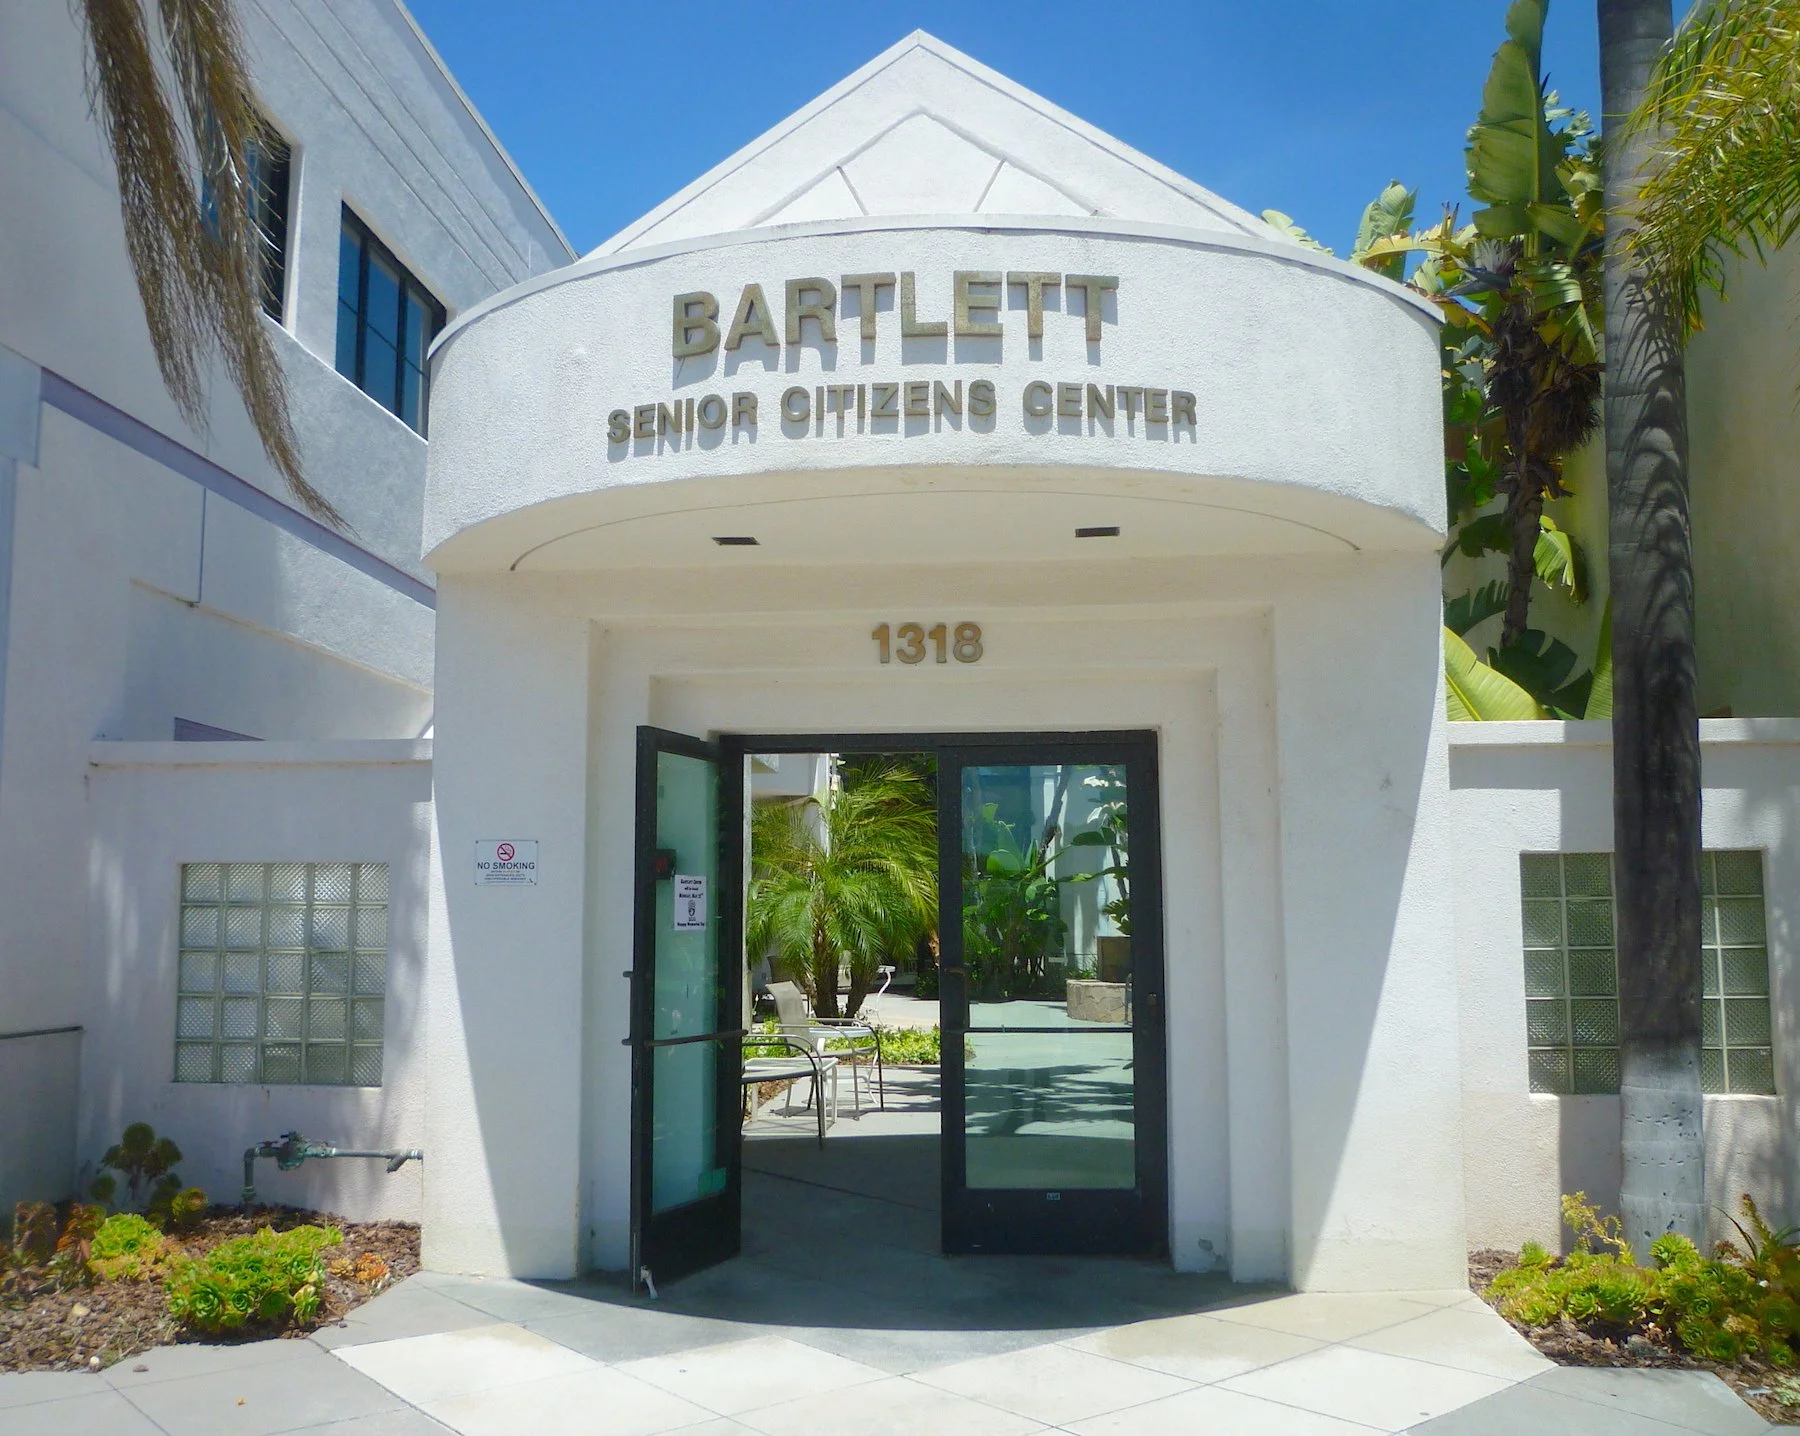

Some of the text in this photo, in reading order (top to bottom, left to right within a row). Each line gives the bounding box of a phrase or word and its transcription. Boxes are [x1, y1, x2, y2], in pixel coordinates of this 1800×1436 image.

[672, 270, 1119, 358] BARTLETT
[607, 379, 1197, 443] SENIOR CITIZENS CENTER
[871, 622, 983, 665] 1318
[477, 862, 535, 870] NO SMOKING
